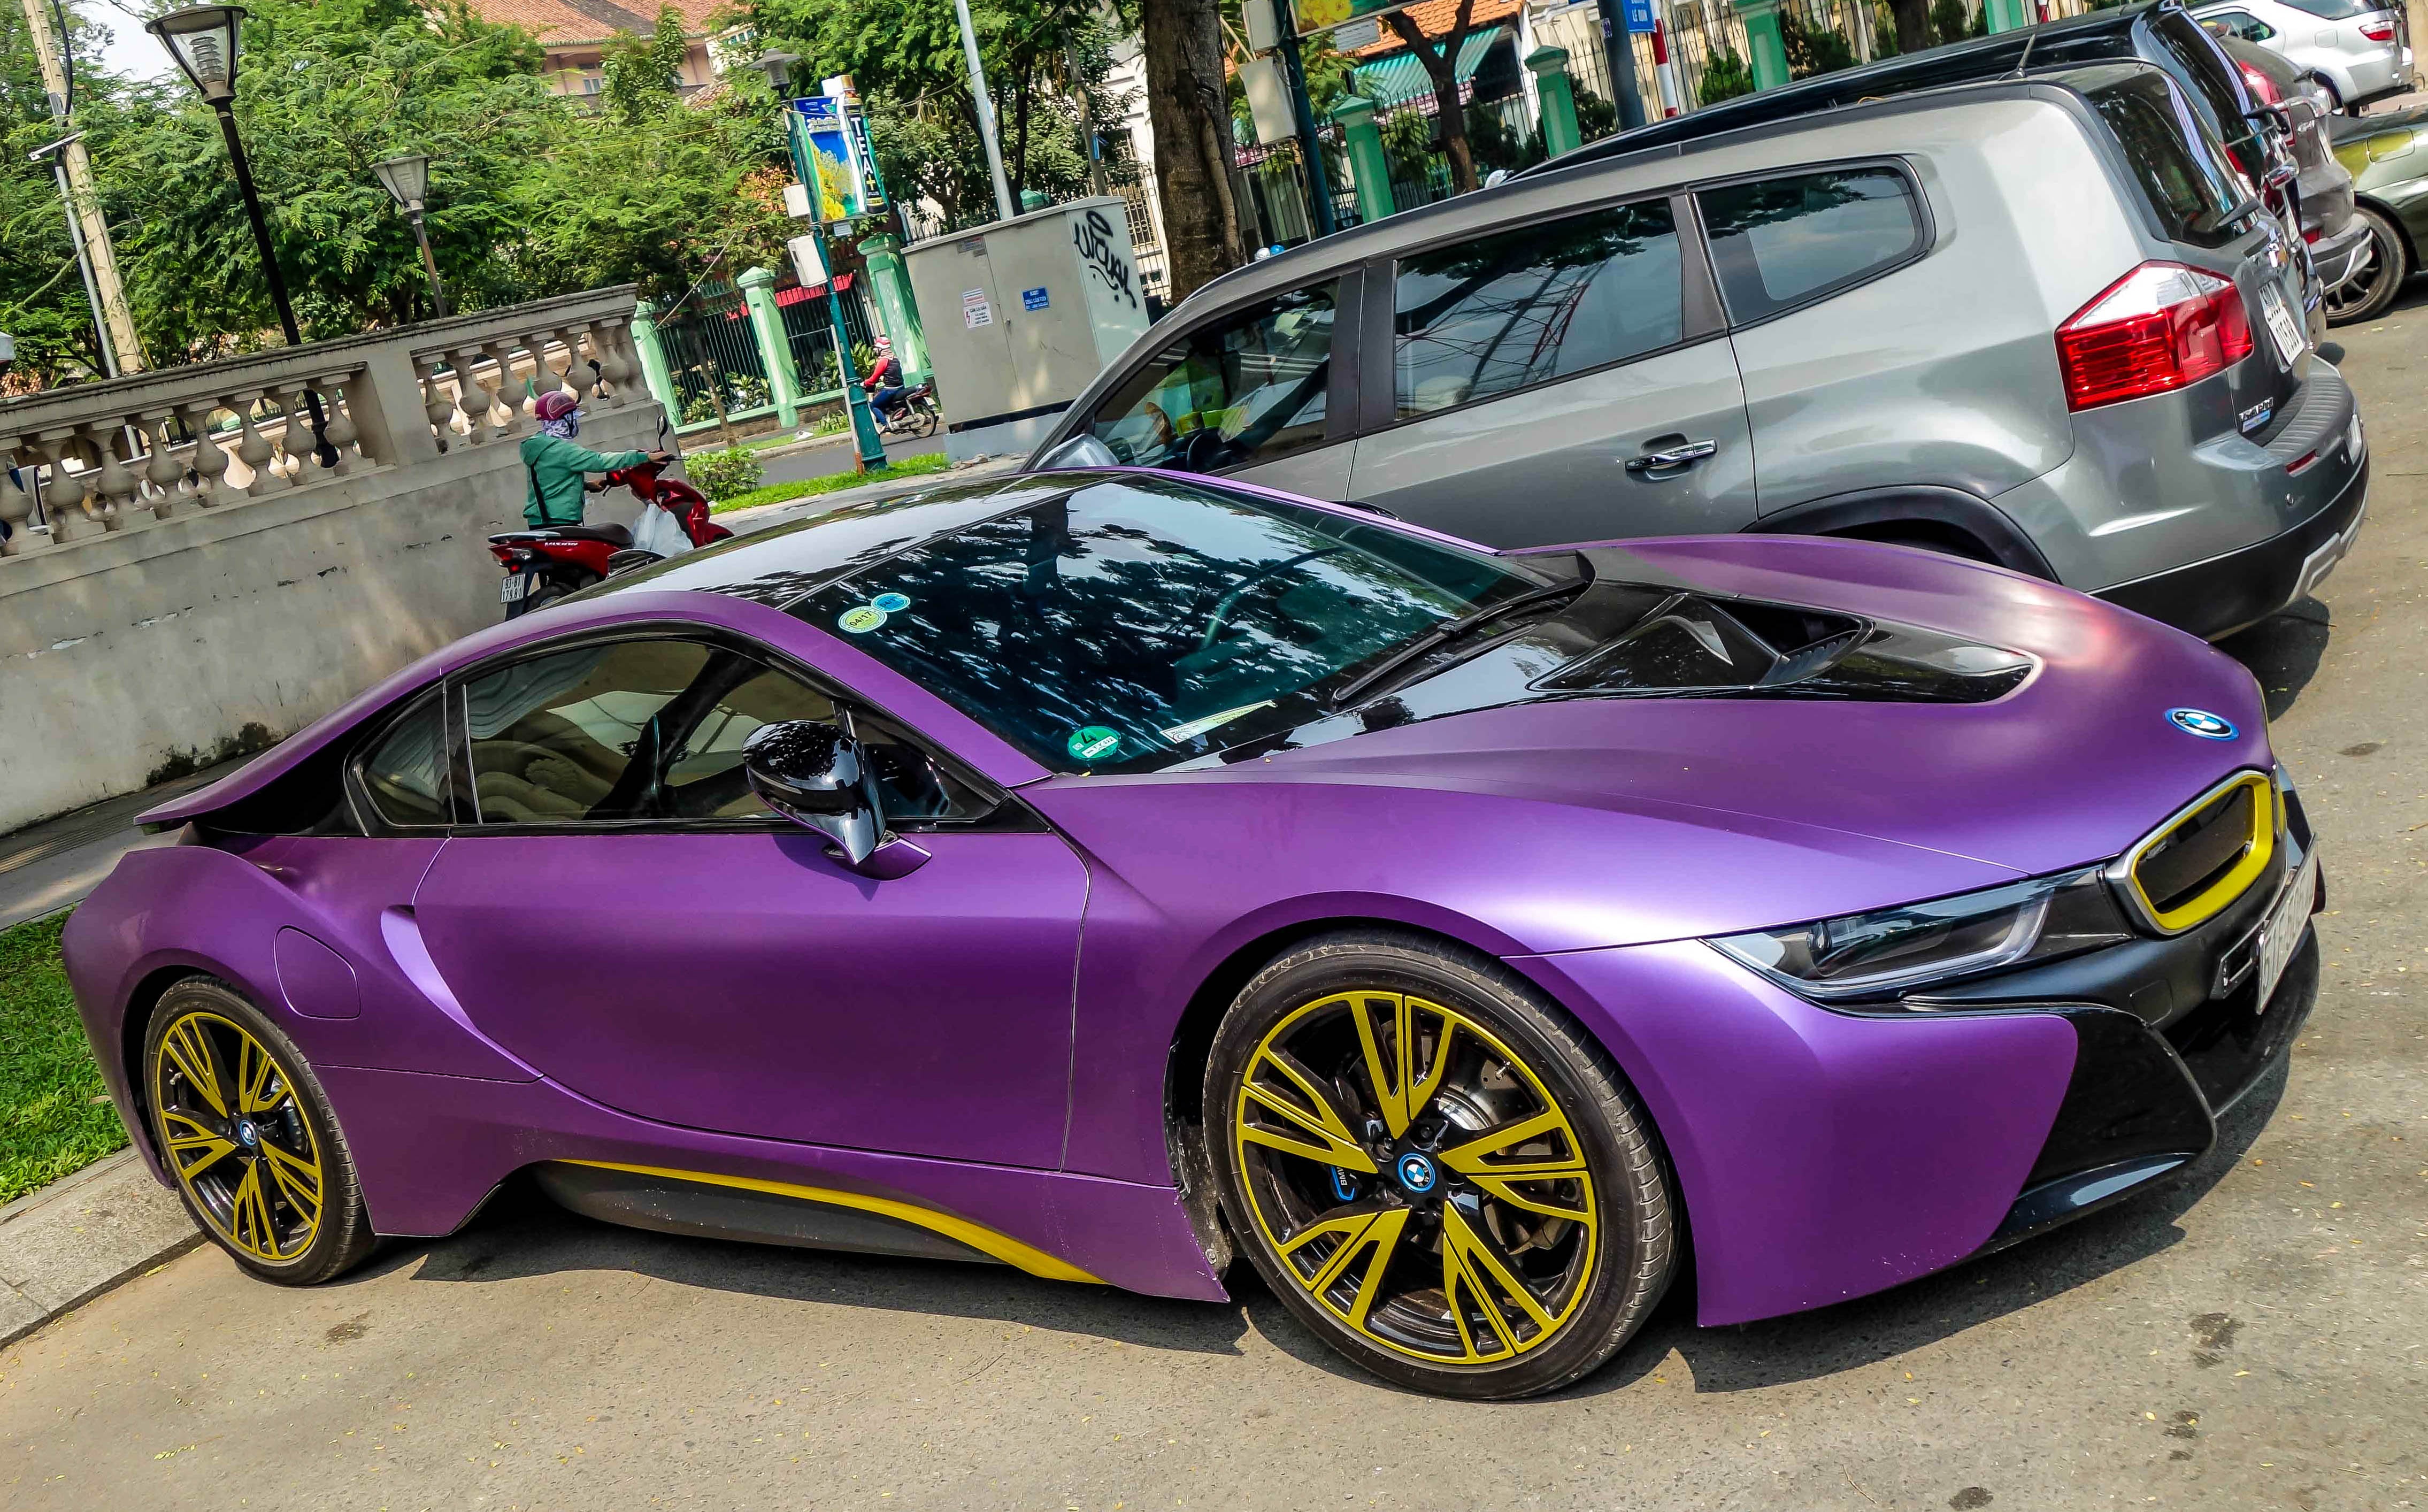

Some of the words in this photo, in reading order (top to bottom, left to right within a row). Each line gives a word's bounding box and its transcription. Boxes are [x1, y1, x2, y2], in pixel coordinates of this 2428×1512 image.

[849, 611, 872, 626] 04/17
[1080, 731, 1097, 744] 4
[1336, 1166, 1348, 1185] BMW
